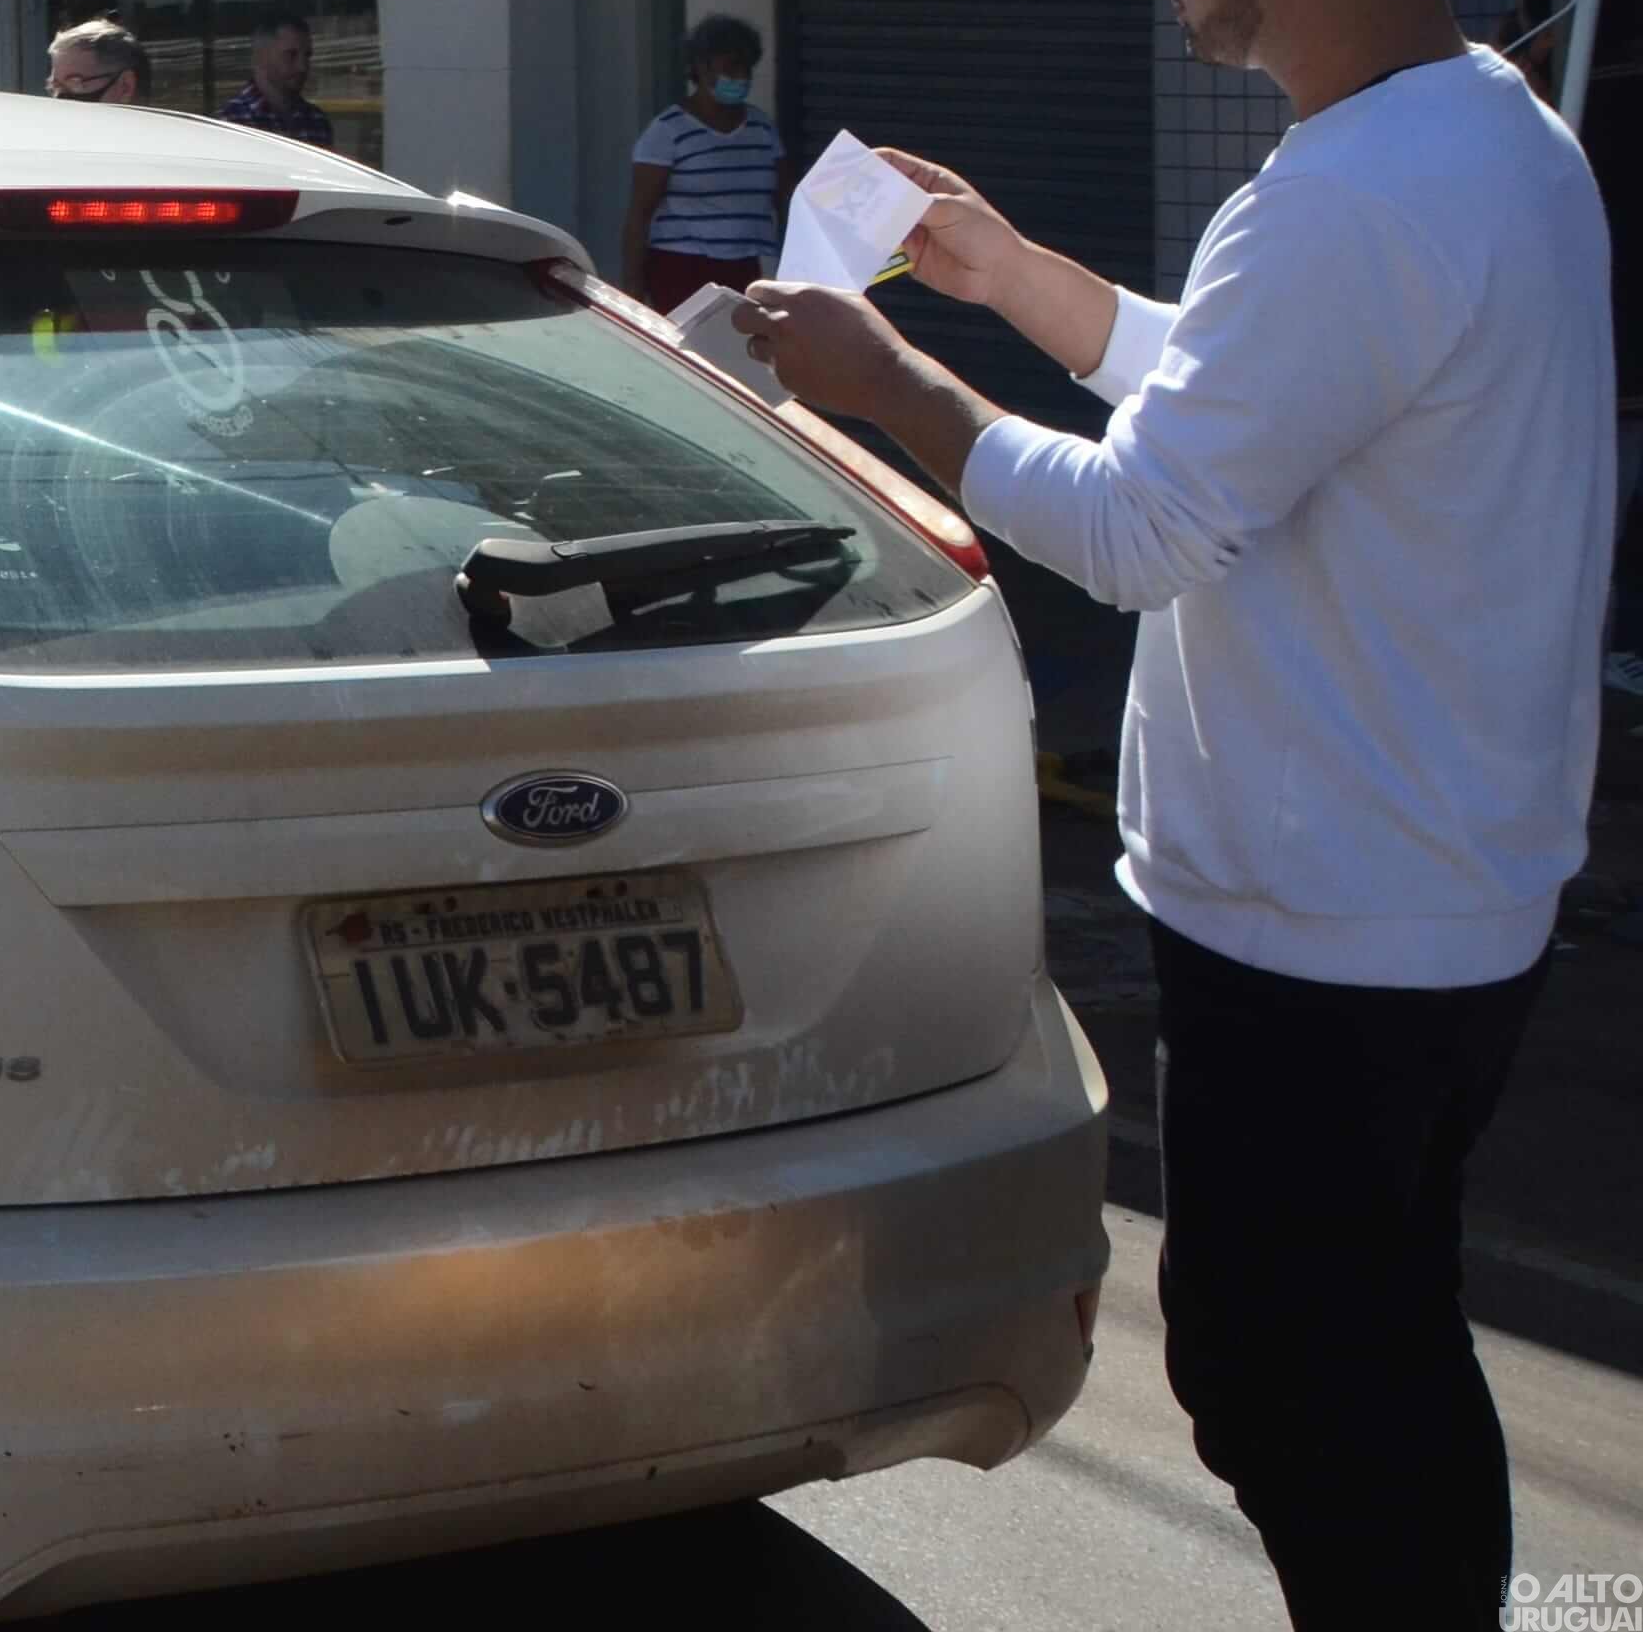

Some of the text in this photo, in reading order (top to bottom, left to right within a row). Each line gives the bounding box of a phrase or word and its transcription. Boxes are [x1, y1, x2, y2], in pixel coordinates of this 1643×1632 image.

[523, 785, 601, 828] Ford
[379, 920, 407, 945] RS
[428, 911, 535, 939] FREDERICO
